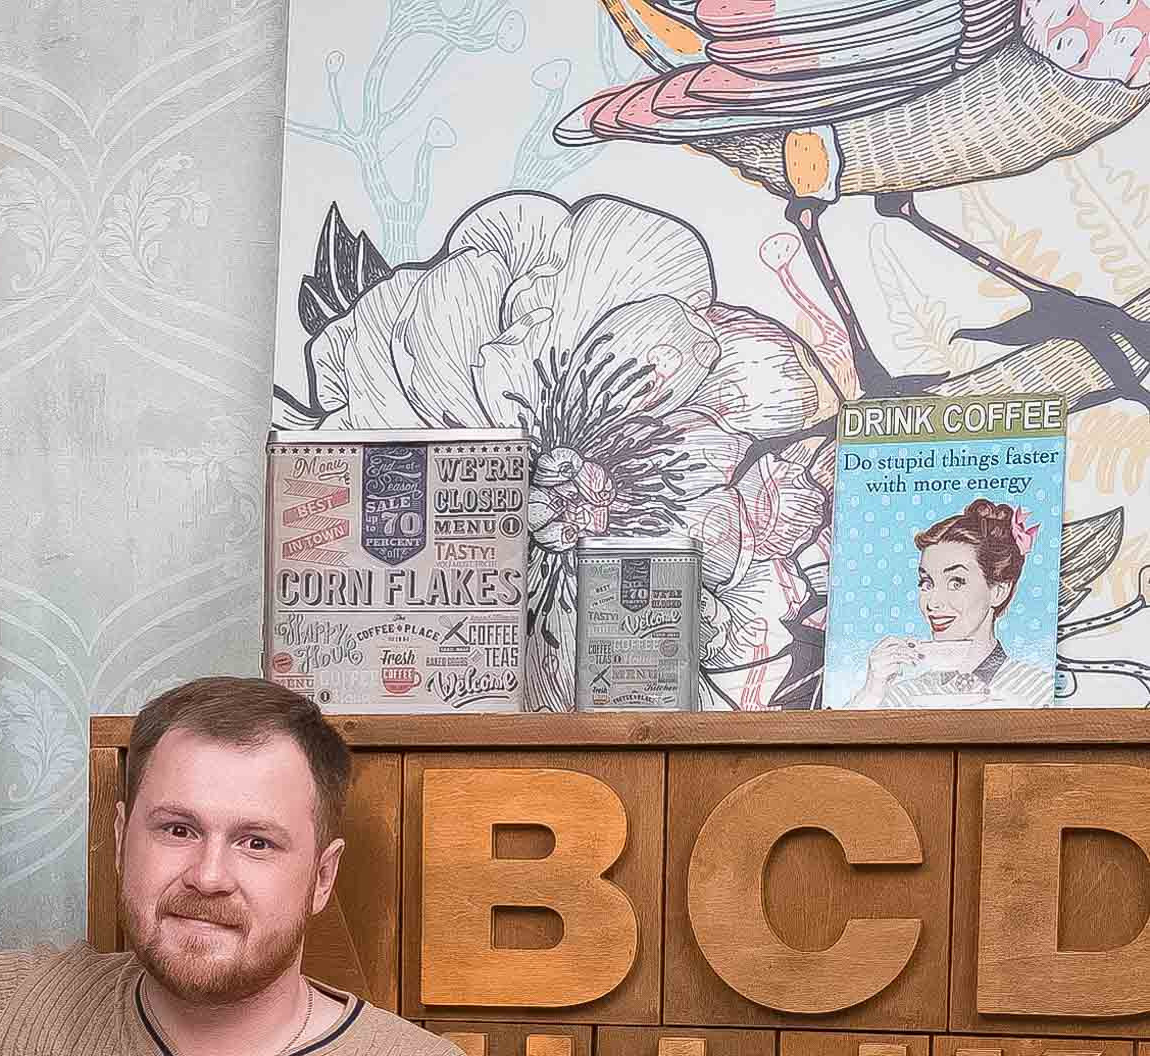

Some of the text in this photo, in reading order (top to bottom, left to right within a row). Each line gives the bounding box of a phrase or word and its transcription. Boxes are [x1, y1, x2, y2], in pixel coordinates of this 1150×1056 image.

[843, 399, 1064, 437] DRINK COFFEE
[434, 456, 524, 482] WE'RE
[844, 447, 1060, 473] Do stupid things faster
[866, 475, 1033, 493] with more energy
[296, 496, 334, 518] BEST
[366, 497, 411, 512] SALE
[434, 487, 524, 513] CLOSED
[381, 511, 424, 537] 70
[434, 520, 497, 534] MENU
[288, 525, 346, 554] IN TOWN
[366, 538, 423, 547] PERCENT
[434, 542, 496, 560] TASTY!
[276, 568, 523, 606] CORN FLAKES
[357, 623, 441, 642] COFFEE PLACE
[469, 625, 519, 645] COFFEE
[380, 650, 416, 665] Fresh
[485, 648, 519, 667] TEAS
[383, 668, 413, 680] COFFEE
[421, 763, 1150, 1018] B C D
